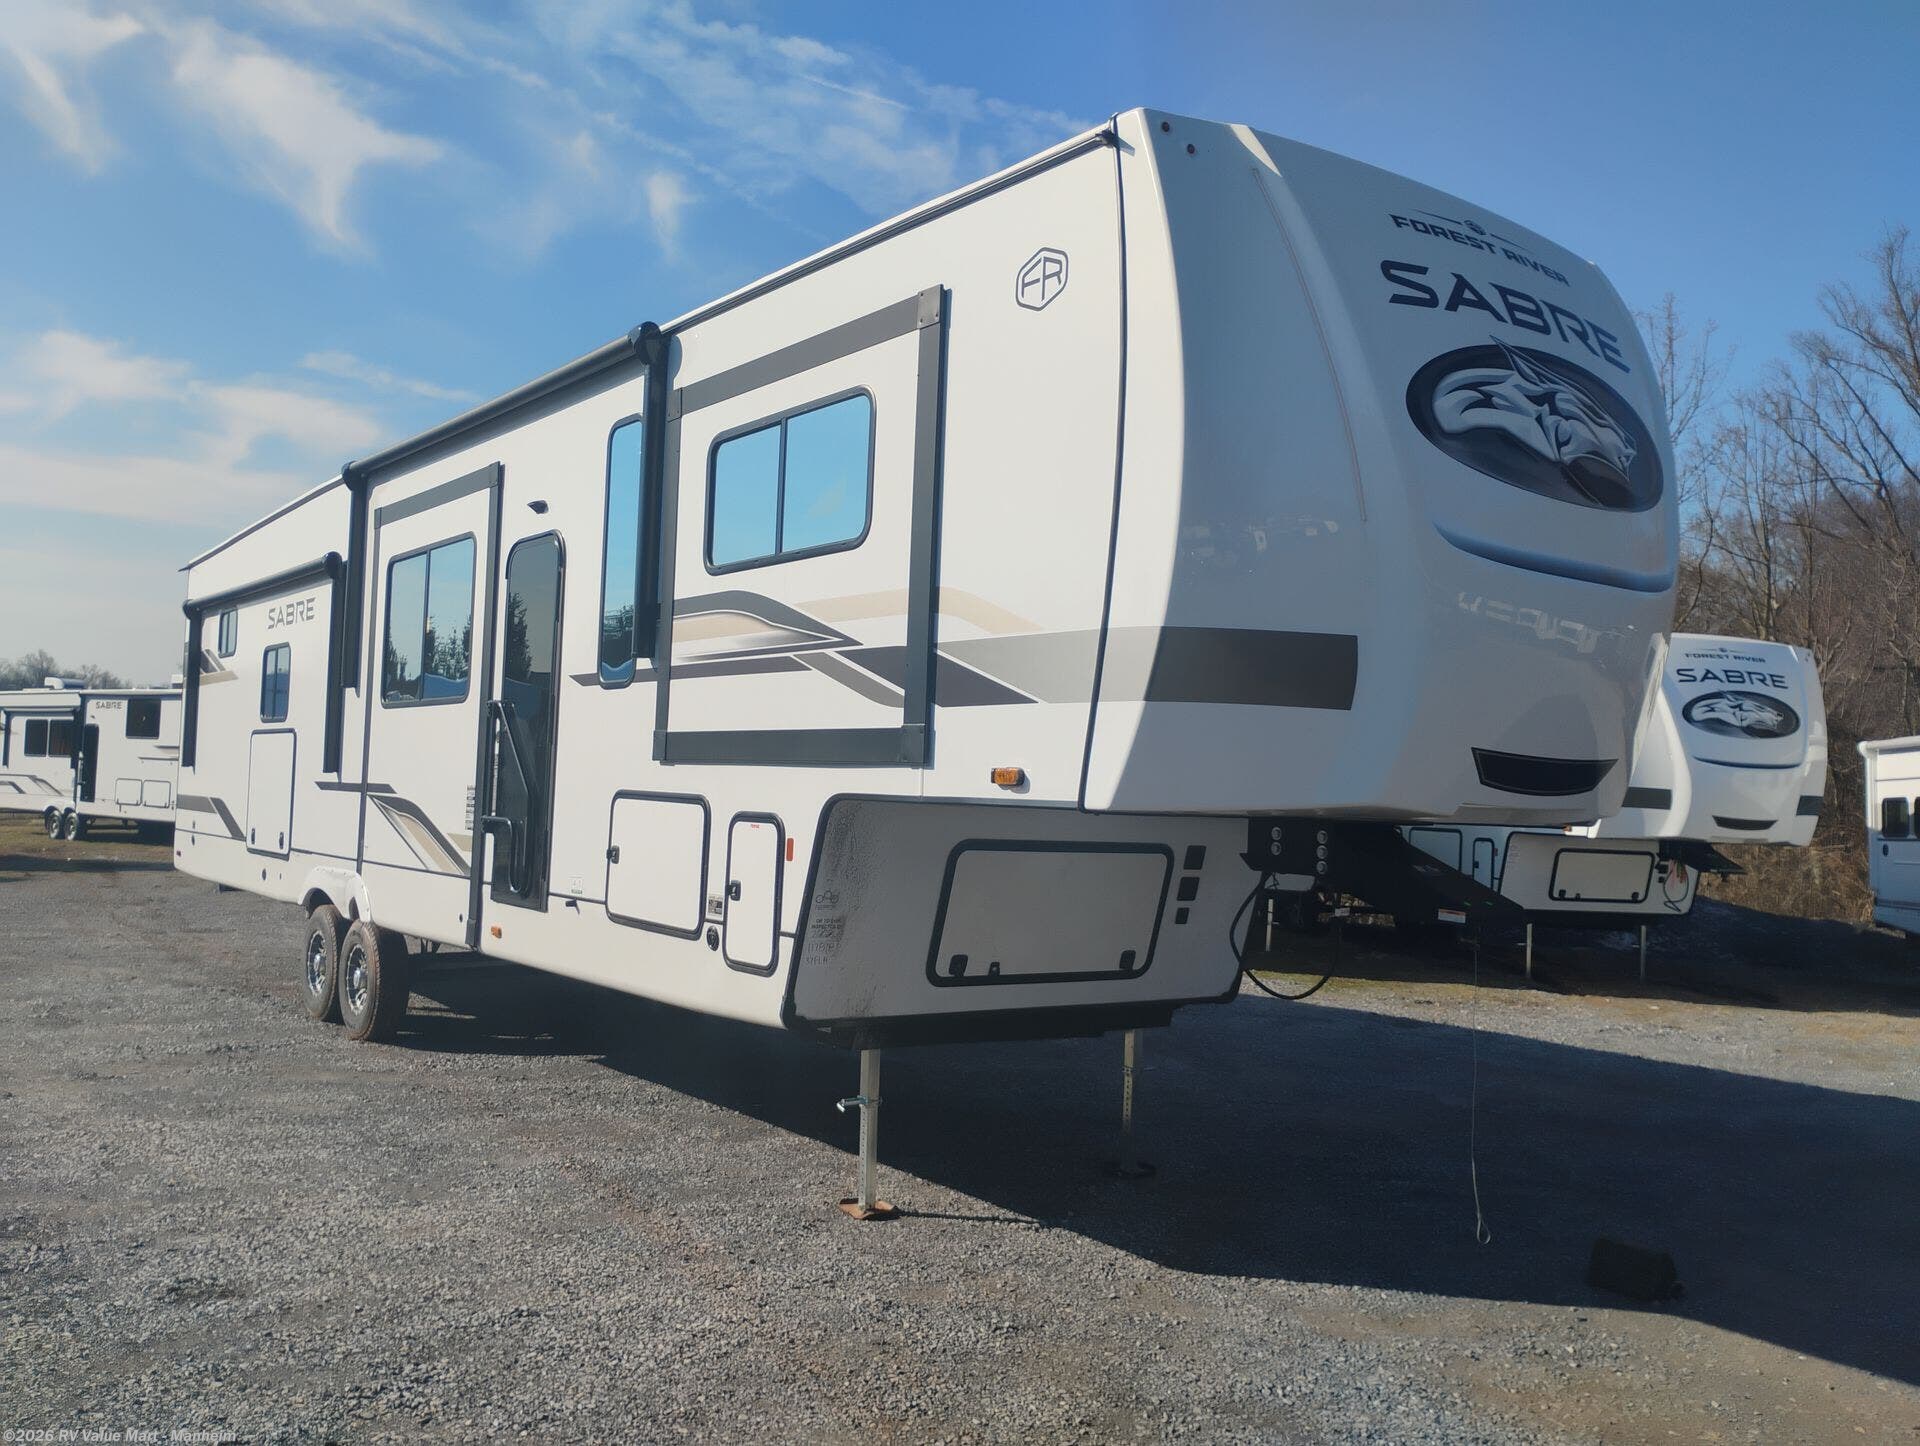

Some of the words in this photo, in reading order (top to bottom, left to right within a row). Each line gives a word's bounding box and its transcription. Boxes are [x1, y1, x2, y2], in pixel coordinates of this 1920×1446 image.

[1388, 213, 1496, 254] FOREST
[1500, 248, 1571, 287] RIVER
[1380, 259, 1631, 374] SABRE
[267, 597, 316, 629] SABRE
[1685, 653, 1729, 661] FOREST
[1733, 655, 1766, 663] RIVER
[1676, 668, 1789, 689] SABRE
[95, 701, 123, 710] SABRE
